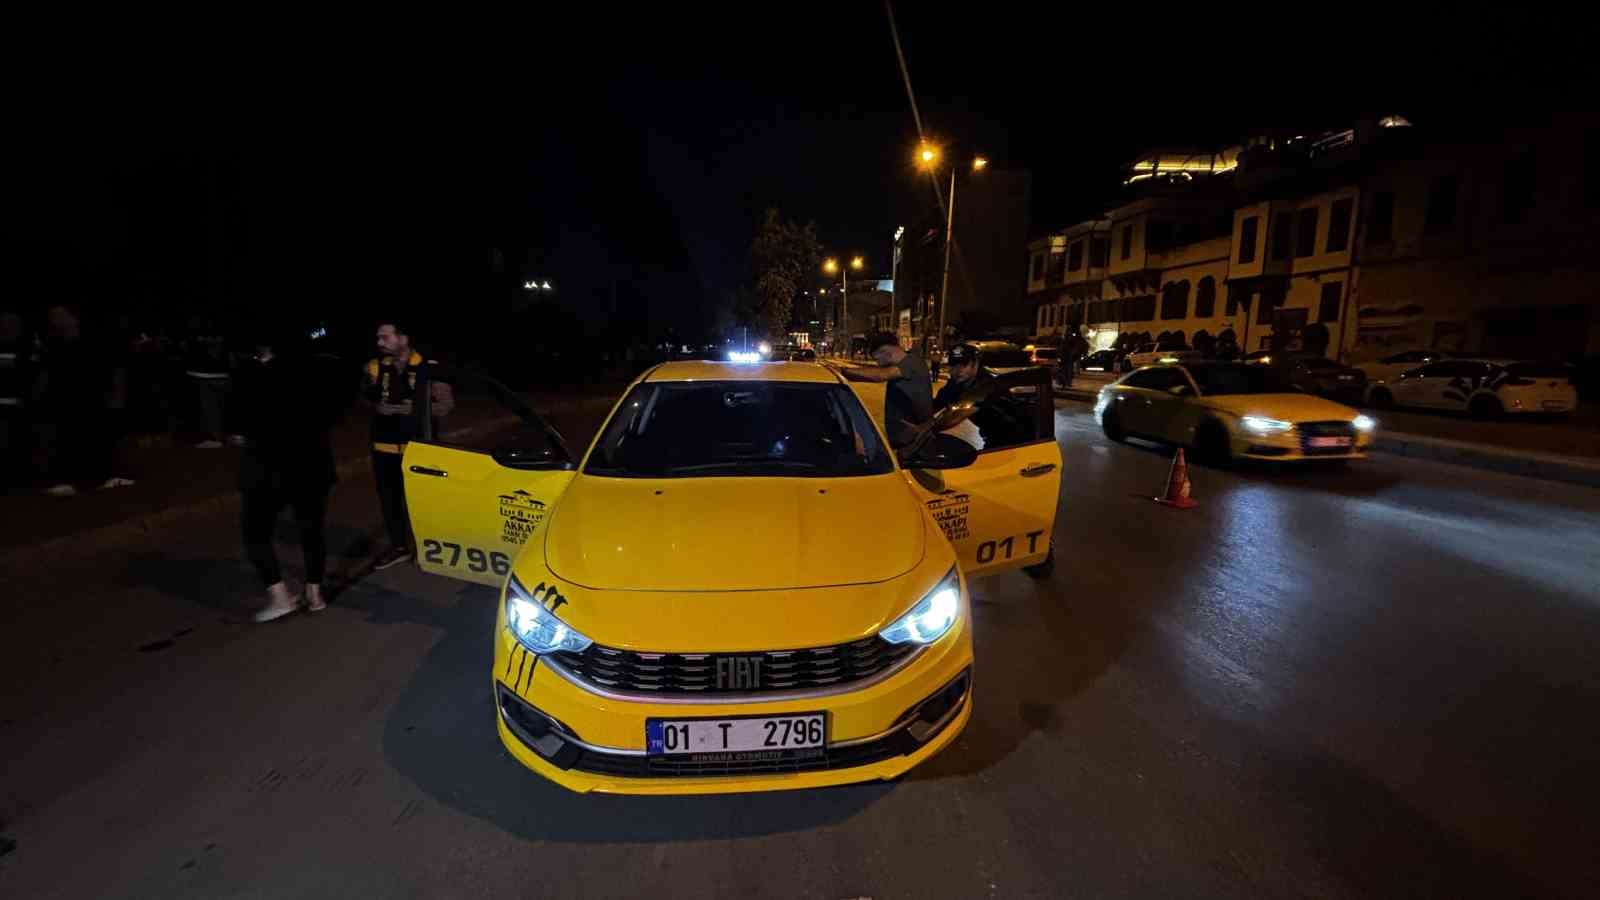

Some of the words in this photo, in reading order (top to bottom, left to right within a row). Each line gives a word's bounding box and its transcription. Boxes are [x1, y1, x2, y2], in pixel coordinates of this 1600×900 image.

[423, 539, 510, 576] 2796
[976, 536, 1015, 563] 01
[1026, 529, 1045, 553] T
[716, 656, 765, 689] FIAT
[664, 725, 690, 750] 01
[718, 723, 732, 748] T
[764, 719, 822, 746] 2796
